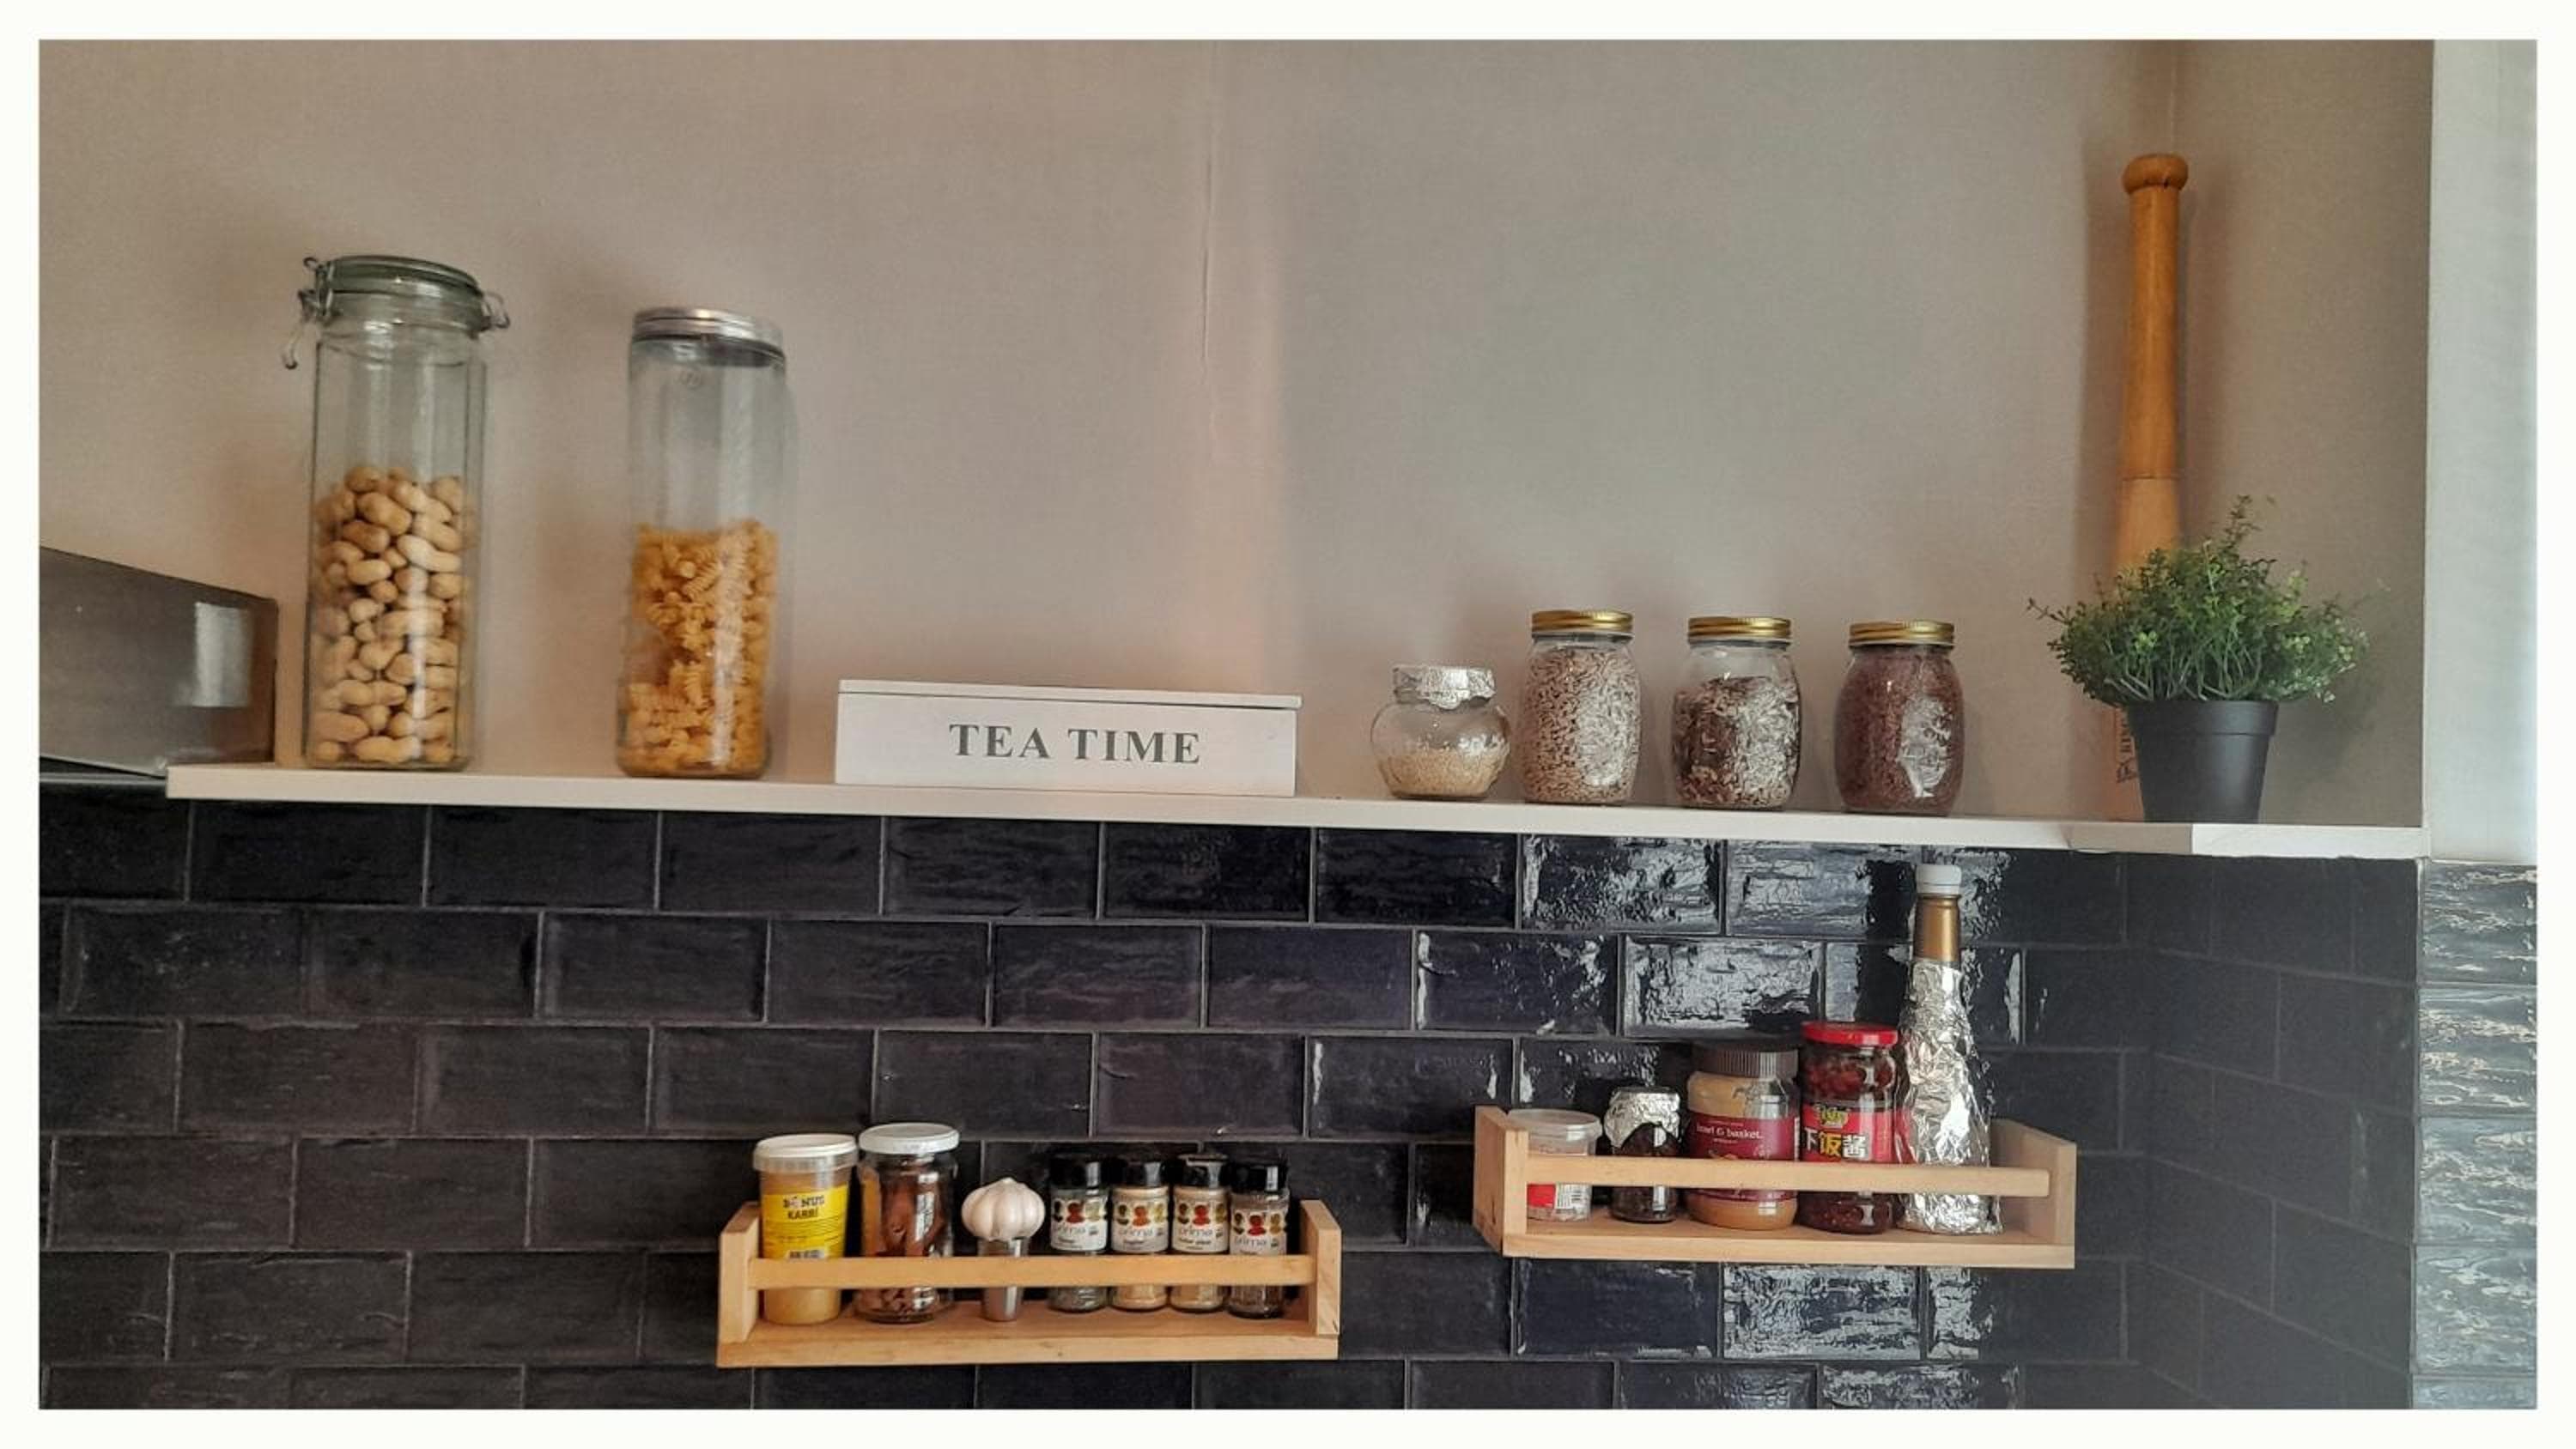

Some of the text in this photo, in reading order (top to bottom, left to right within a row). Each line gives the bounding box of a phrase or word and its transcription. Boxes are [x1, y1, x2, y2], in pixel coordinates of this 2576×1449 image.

[949, 724, 1200, 764] TEA TIME
[1804, 1126, 1868, 1159] 下饭酱
